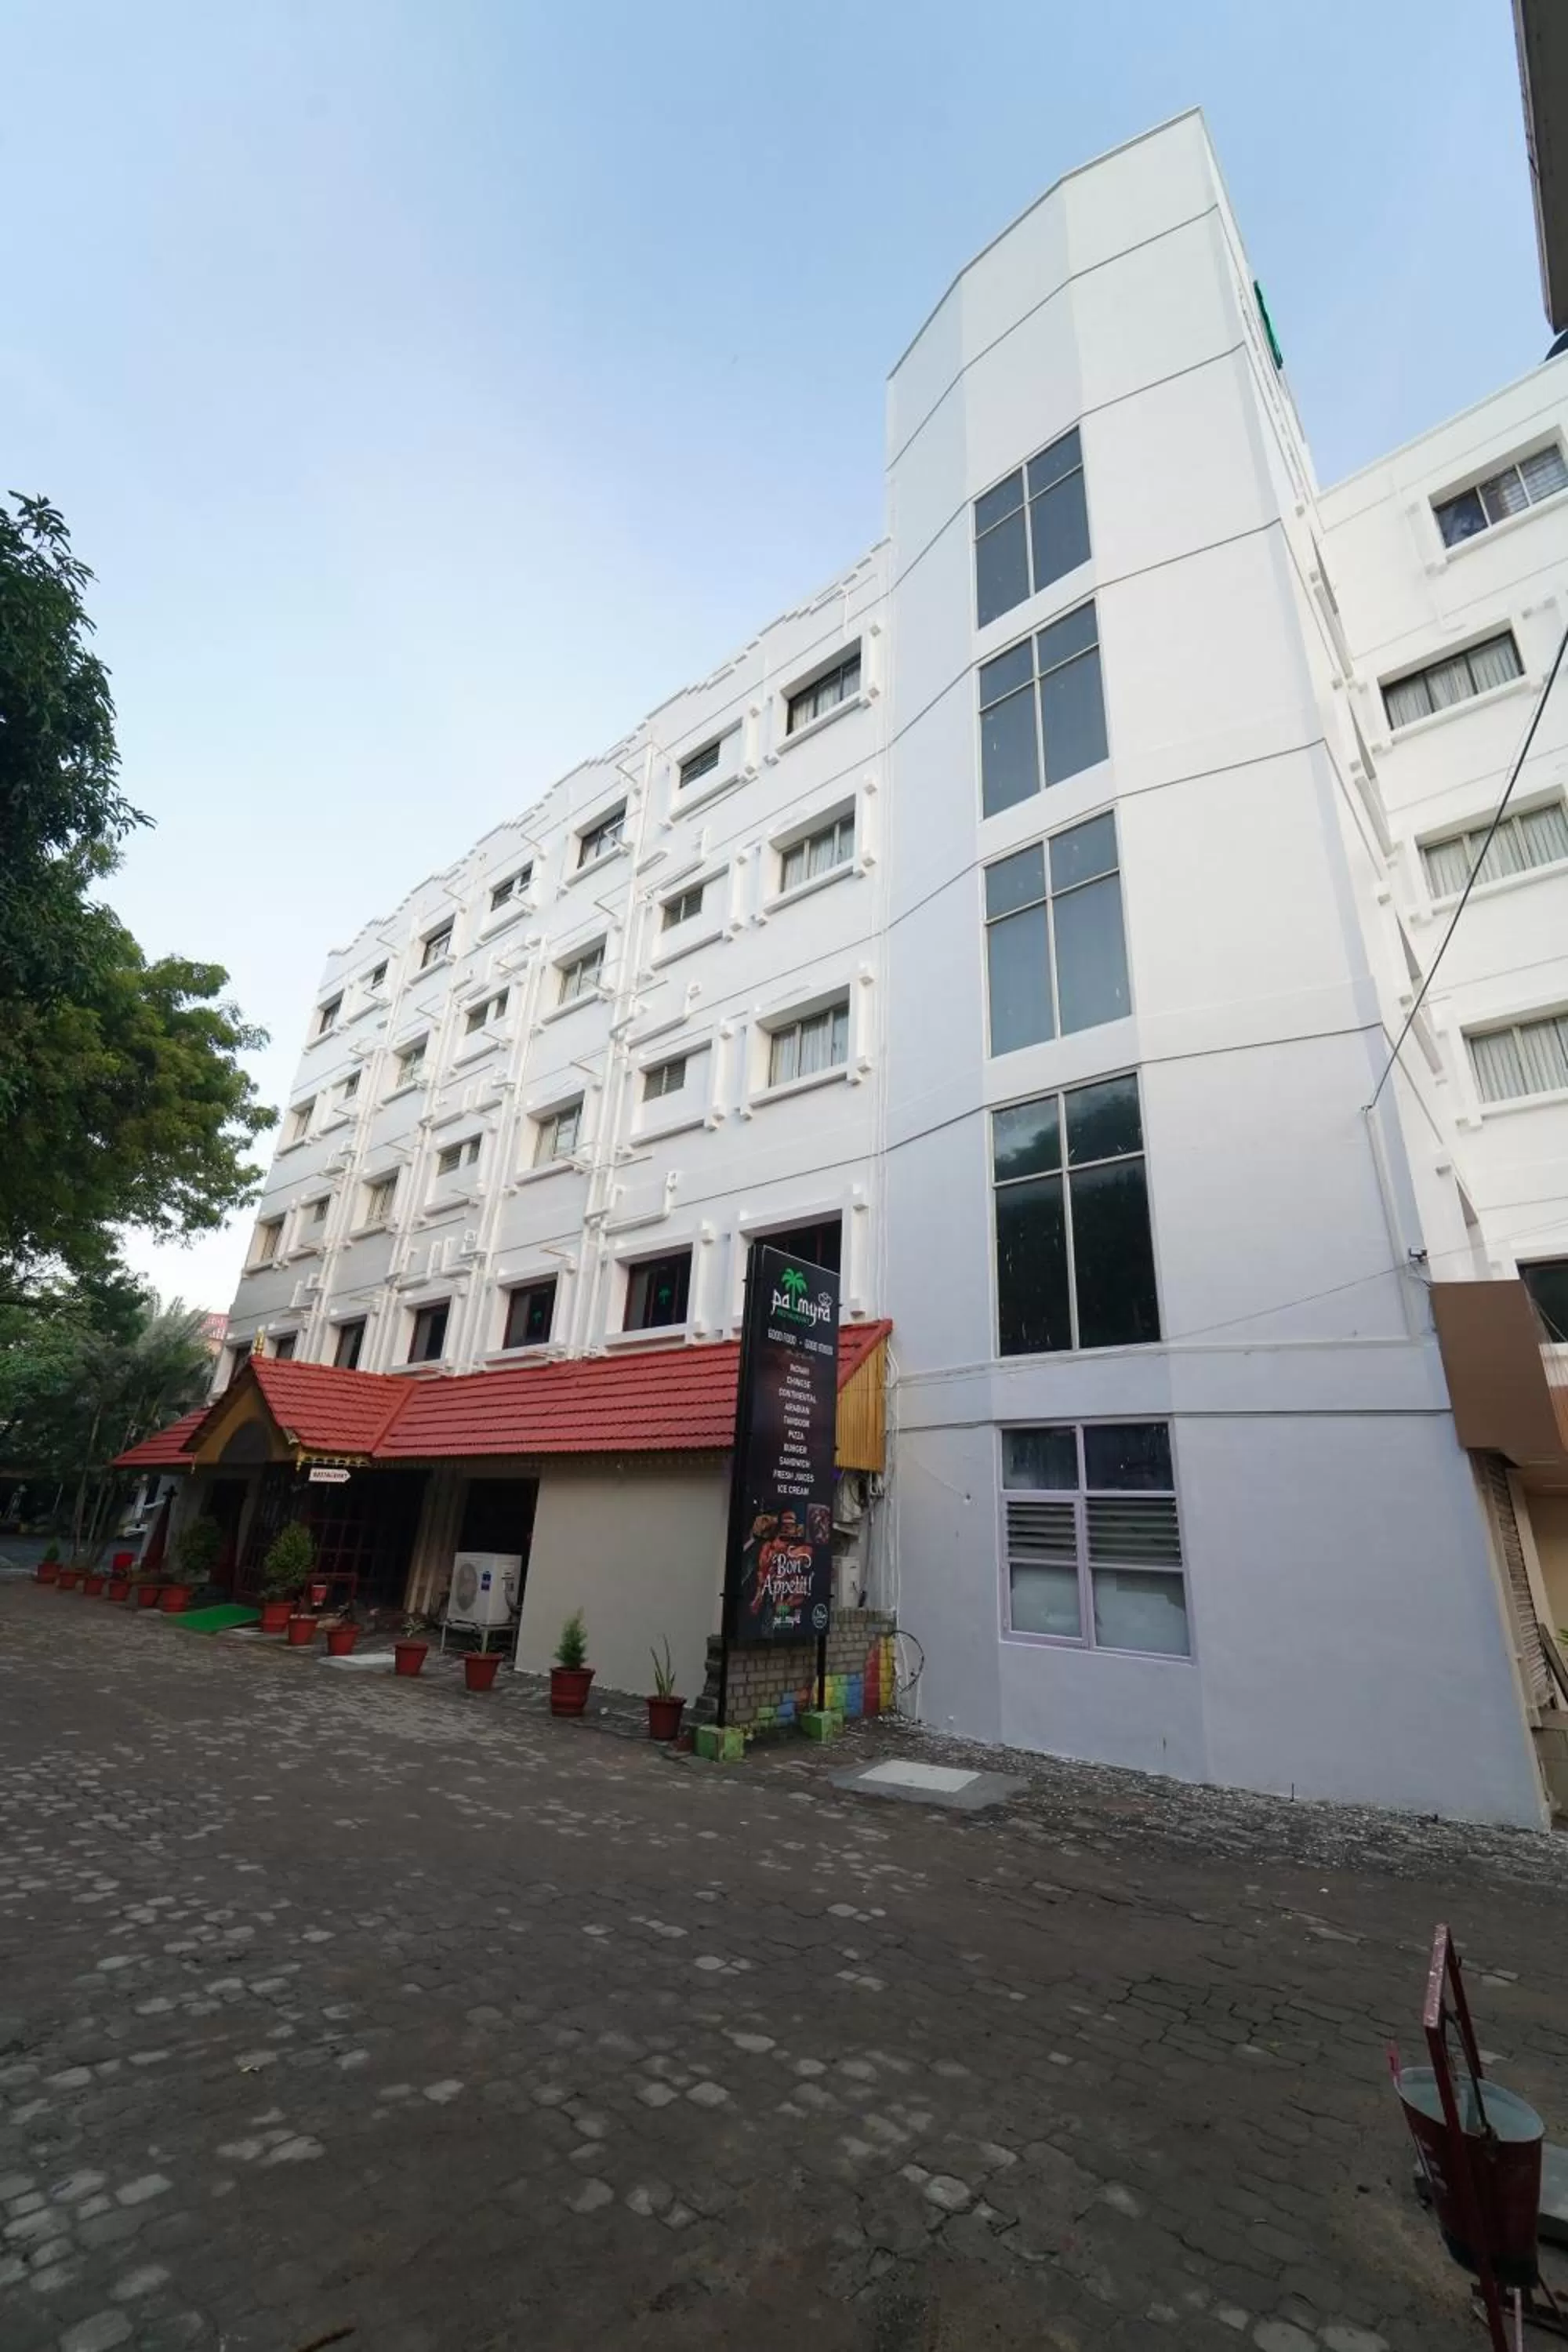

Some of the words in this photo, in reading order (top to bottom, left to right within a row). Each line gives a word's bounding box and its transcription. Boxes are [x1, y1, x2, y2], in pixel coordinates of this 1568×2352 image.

[786, 1376, 811, 1388] CHINESE
[779, 1388, 817, 1404] CONTINENTAL
[785, 1403, 810, 1414] ARABIAN
[783, 1415, 810, 1428] TANDOOR
[788, 1429, 804, 1440] PIZZA
[783, 1443, 808, 1454] BURGER
[779, 1456, 811, 1468] SANDWICH
[772, 1468, 794, 1479] FRESH
[794, 1472, 815, 1483] JUICES
[777, 1484, 788, 1494] ICE
[788, 1486, 810, 1495] CREAM
[771, 1548, 811, 1578] Bon
